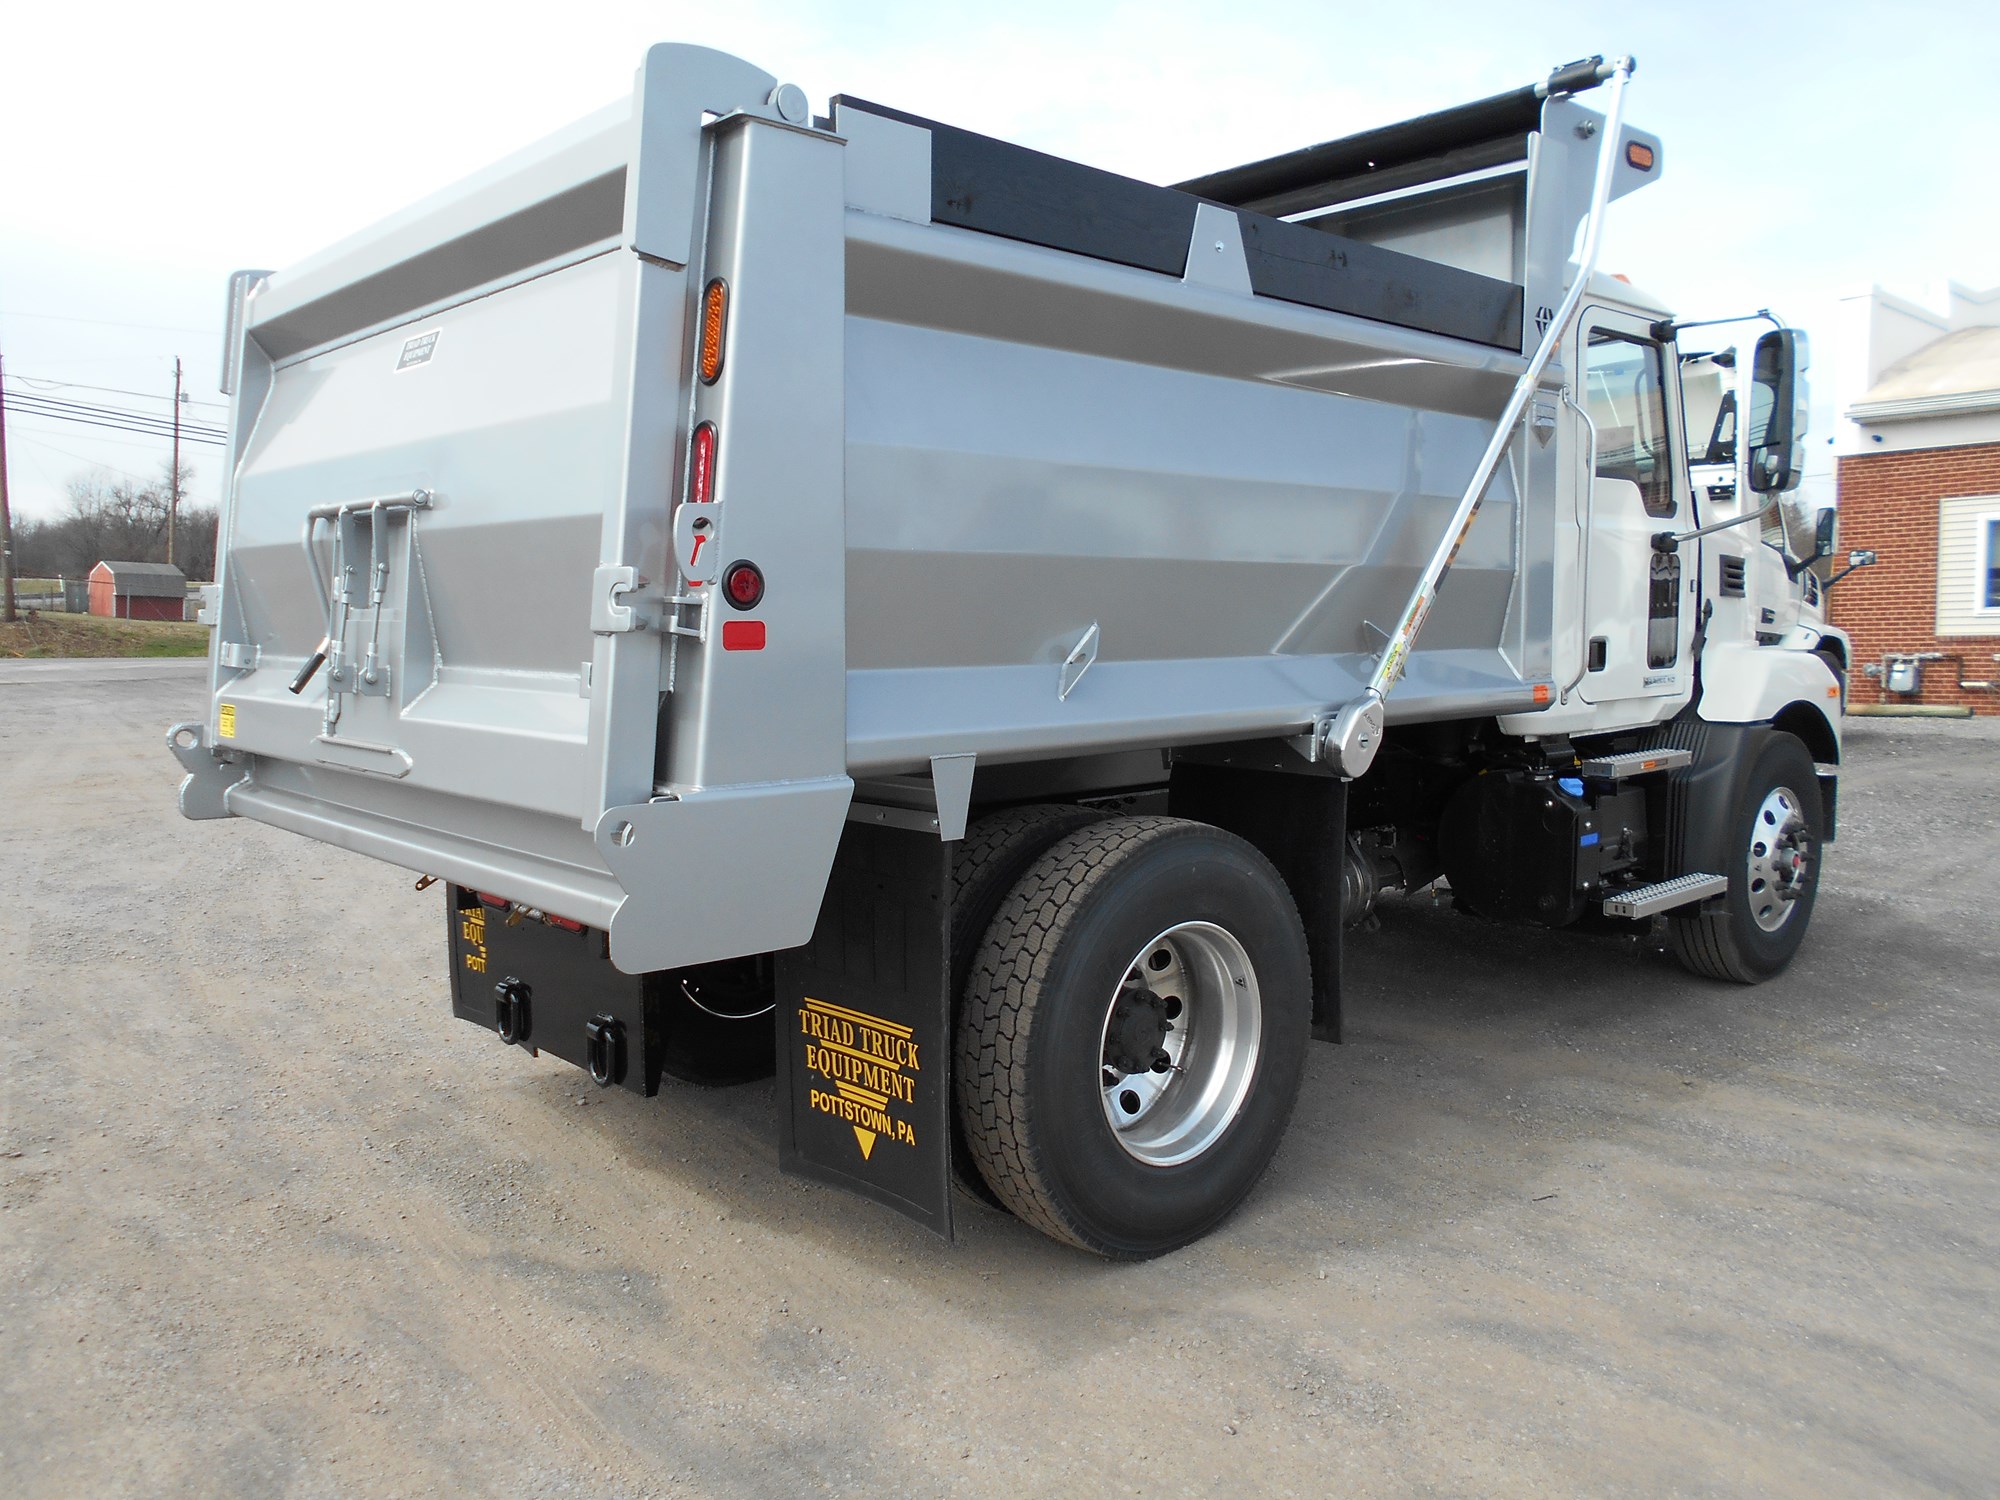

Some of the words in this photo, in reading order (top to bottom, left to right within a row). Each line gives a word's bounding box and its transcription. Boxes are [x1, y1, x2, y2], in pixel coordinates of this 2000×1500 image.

[798, 1008, 854, 1046] TRIAD
[859, 1026, 920, 1071] TRUCK
[806, 1044, 915, 1104] EQUIPMENT
[810, 1089, 895, 1140] POTTSTOWN,
[897, 1119, 916, 1146] PA
